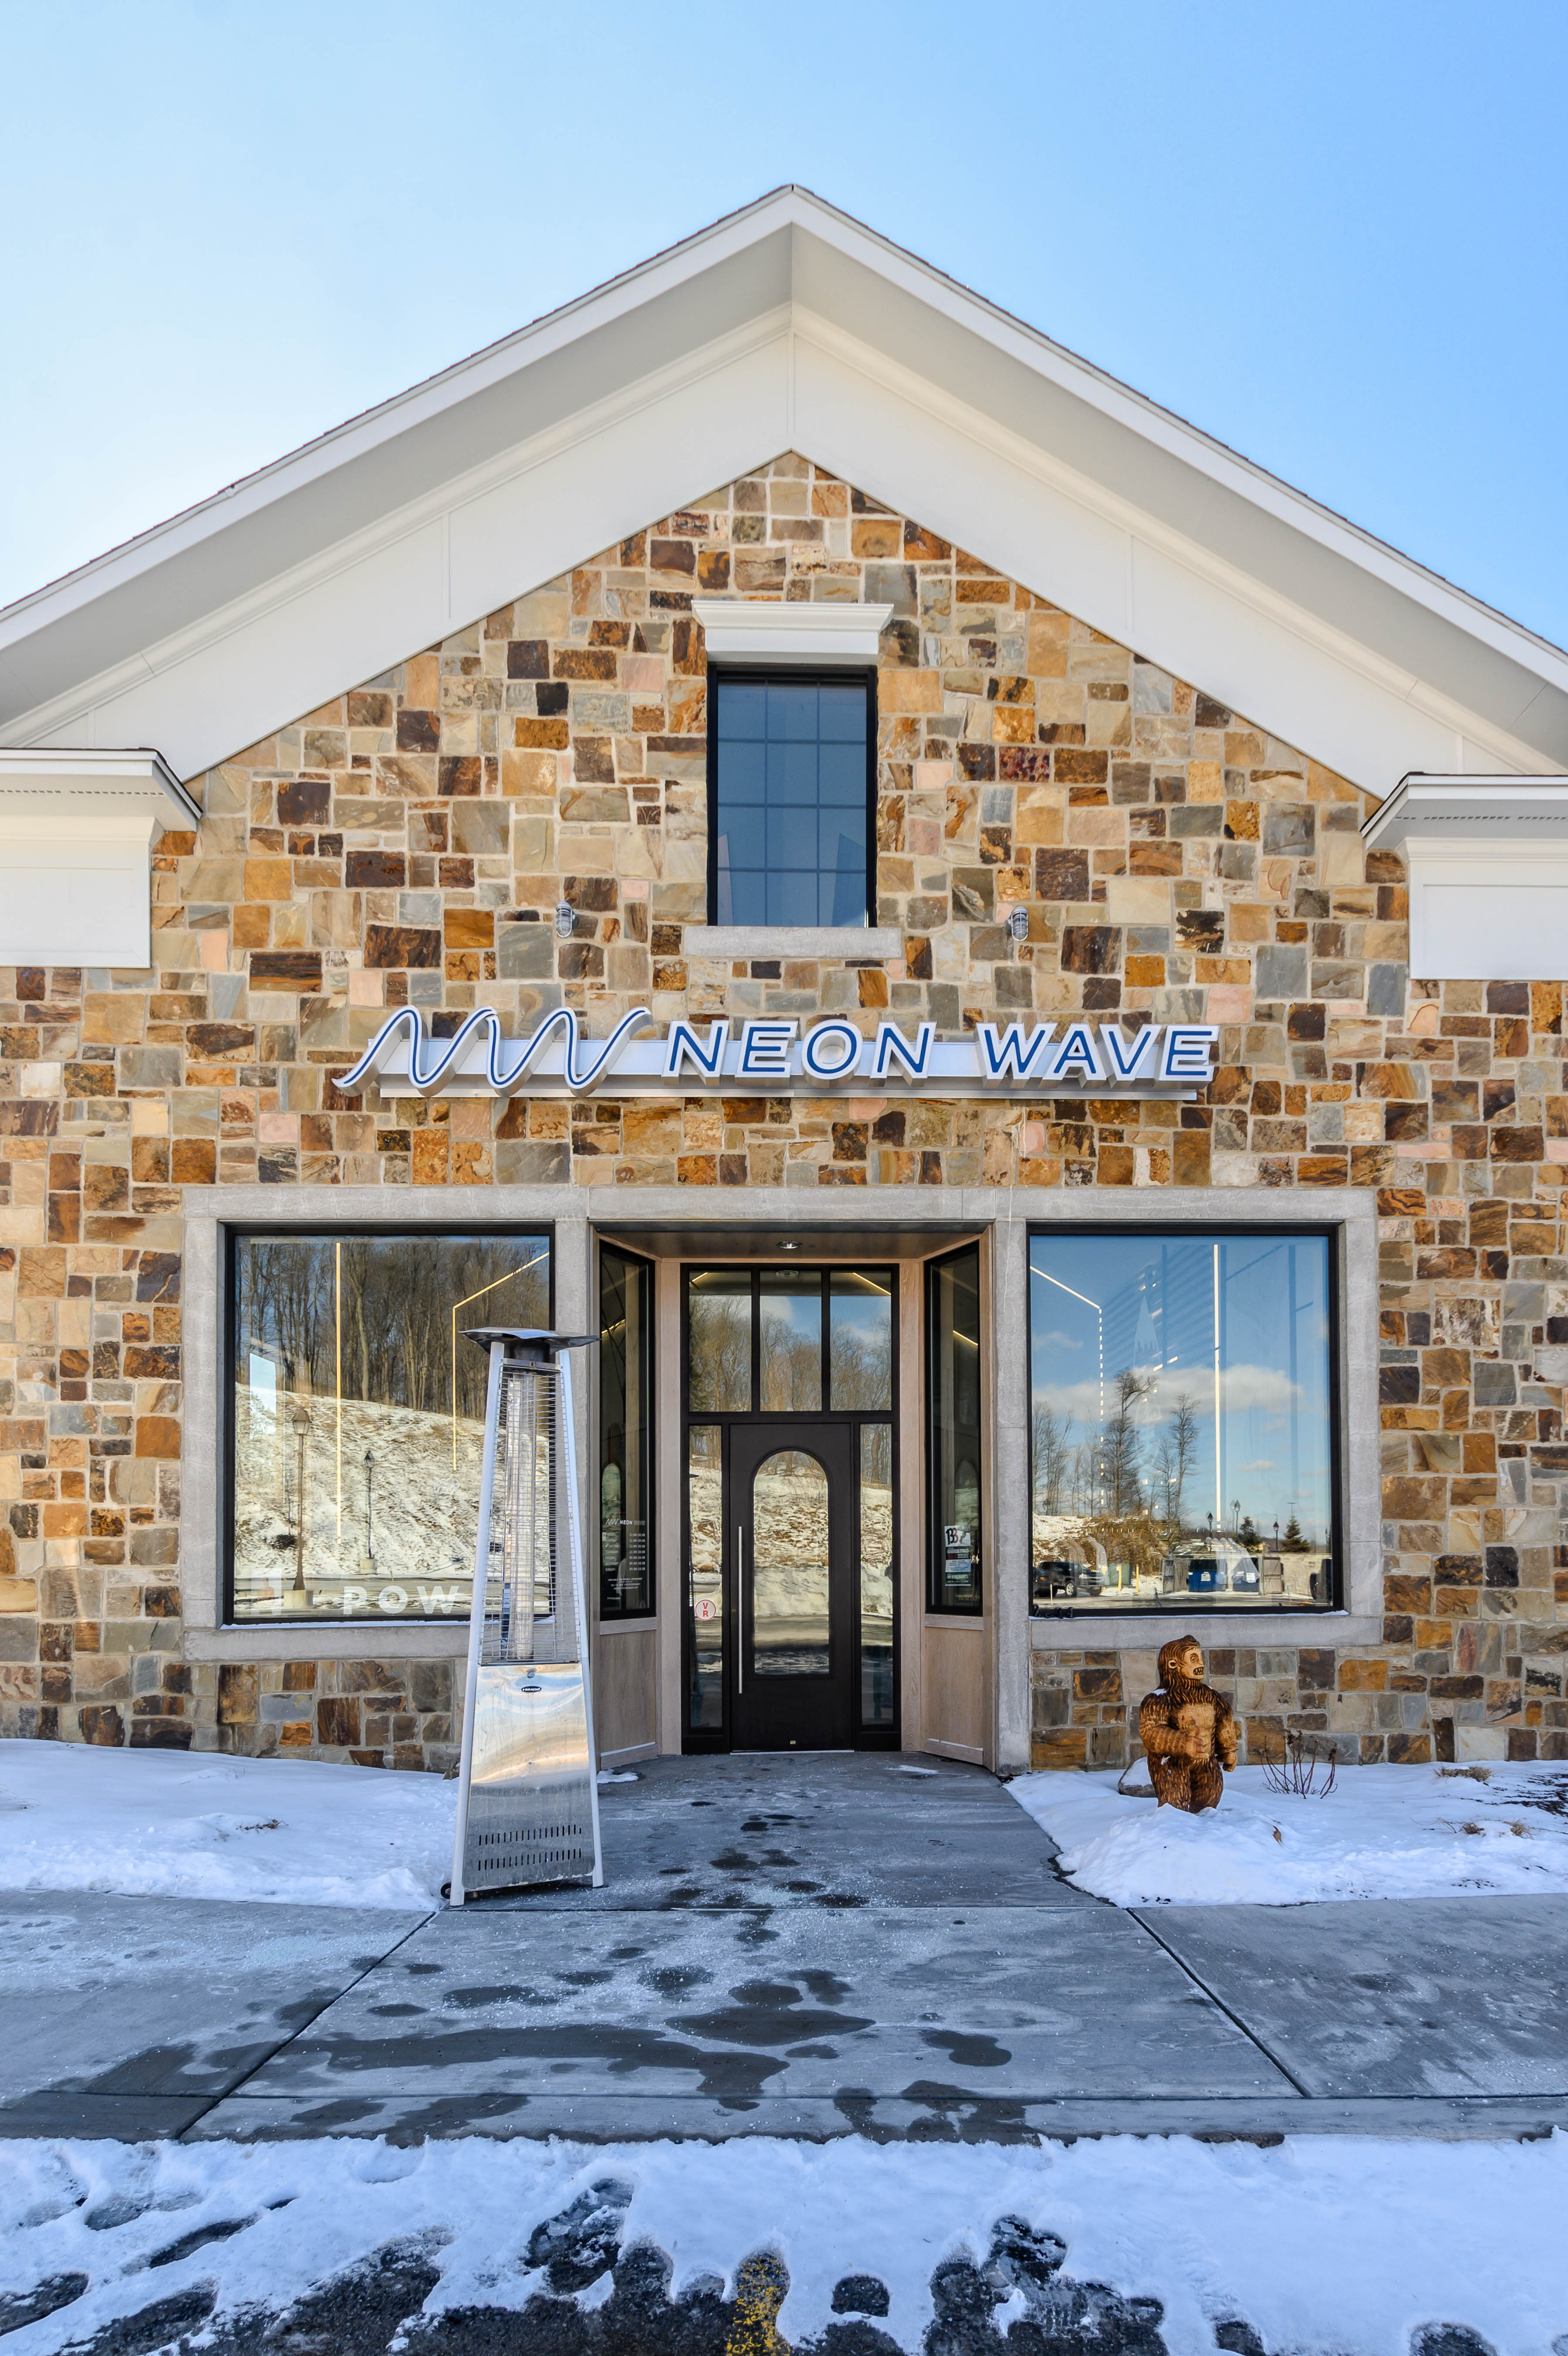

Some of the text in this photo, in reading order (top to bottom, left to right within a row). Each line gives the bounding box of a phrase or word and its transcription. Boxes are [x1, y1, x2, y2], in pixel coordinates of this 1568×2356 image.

[662, 1019, 1220, 1082] NEON WAVE
[343, 1585, 460, 1615] POW
